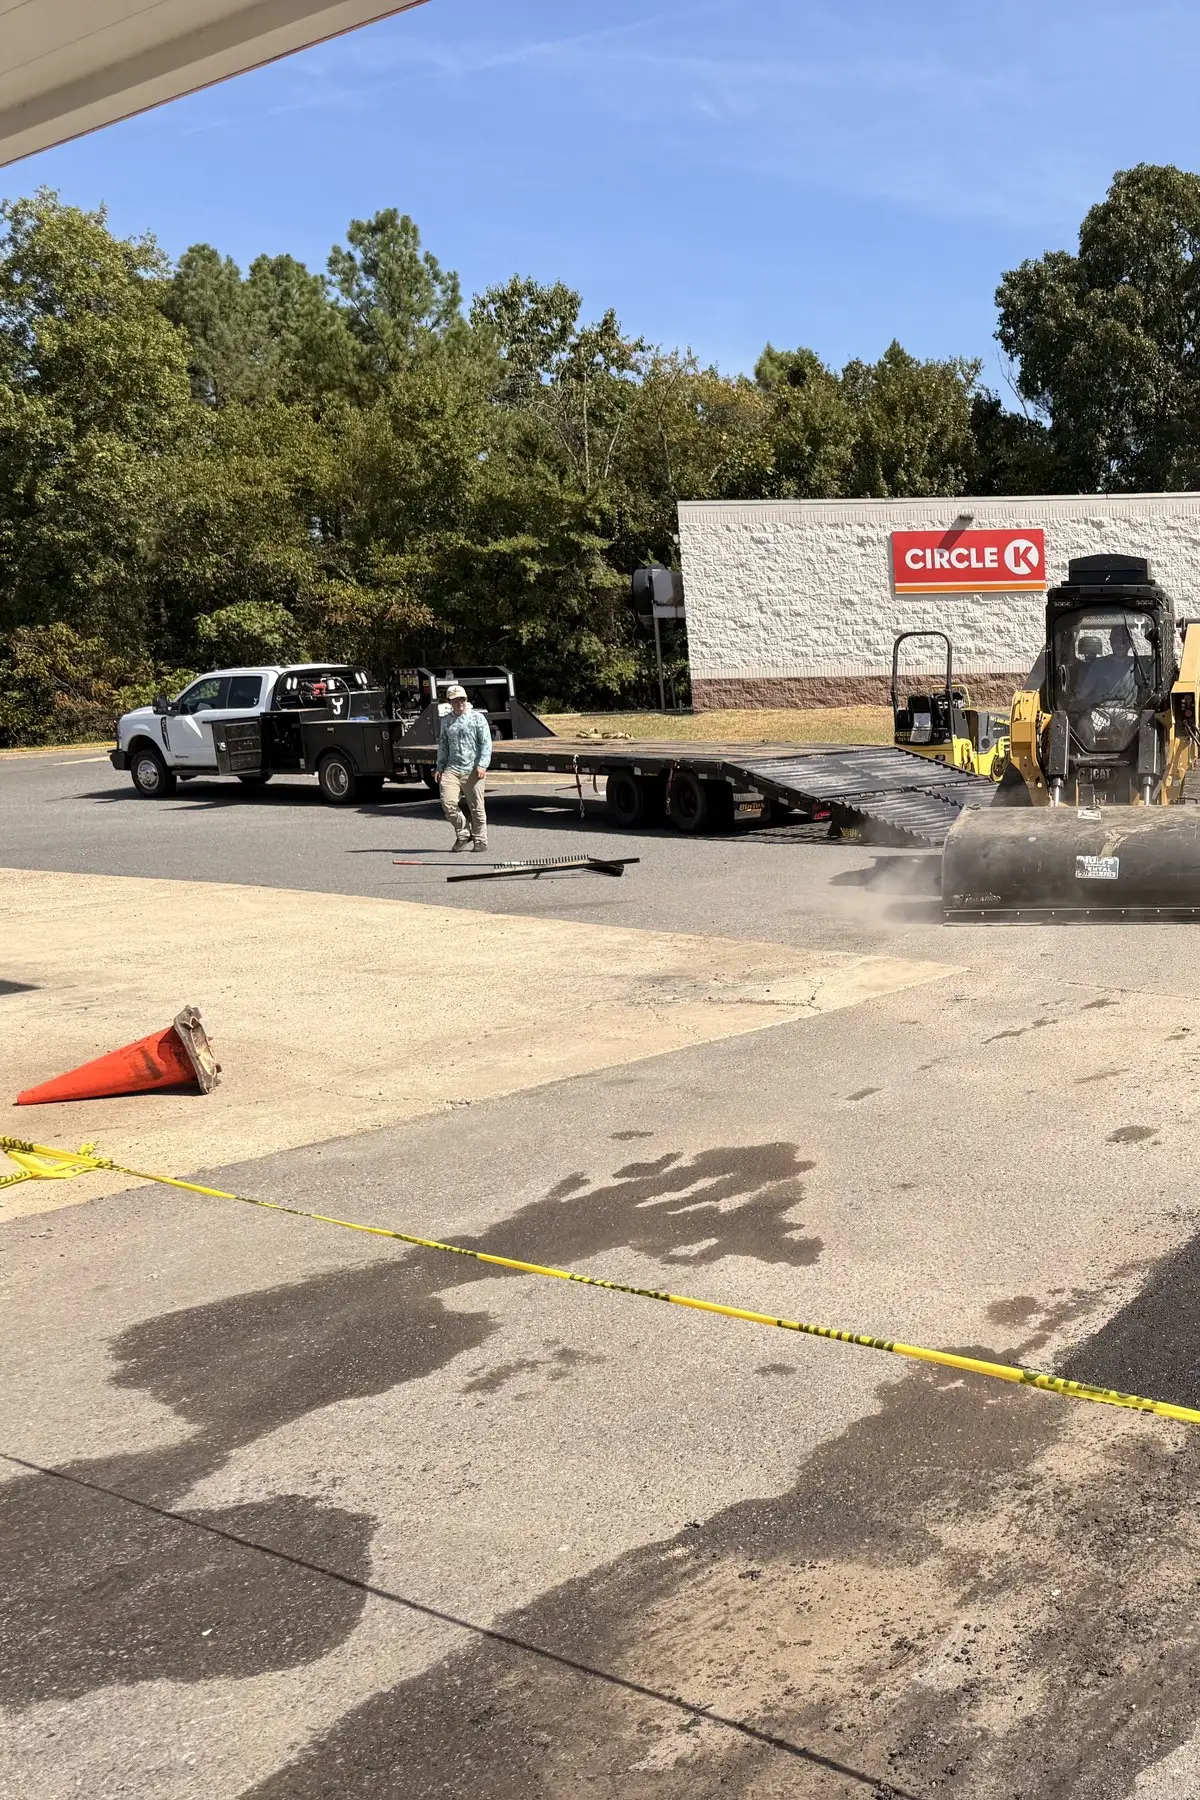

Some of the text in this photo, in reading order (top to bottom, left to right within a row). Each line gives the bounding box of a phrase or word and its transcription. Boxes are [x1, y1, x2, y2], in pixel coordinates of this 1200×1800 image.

[905, 546, 1037, 572] CIRCLE K
[1093, 768, 1111, 779] CAT
